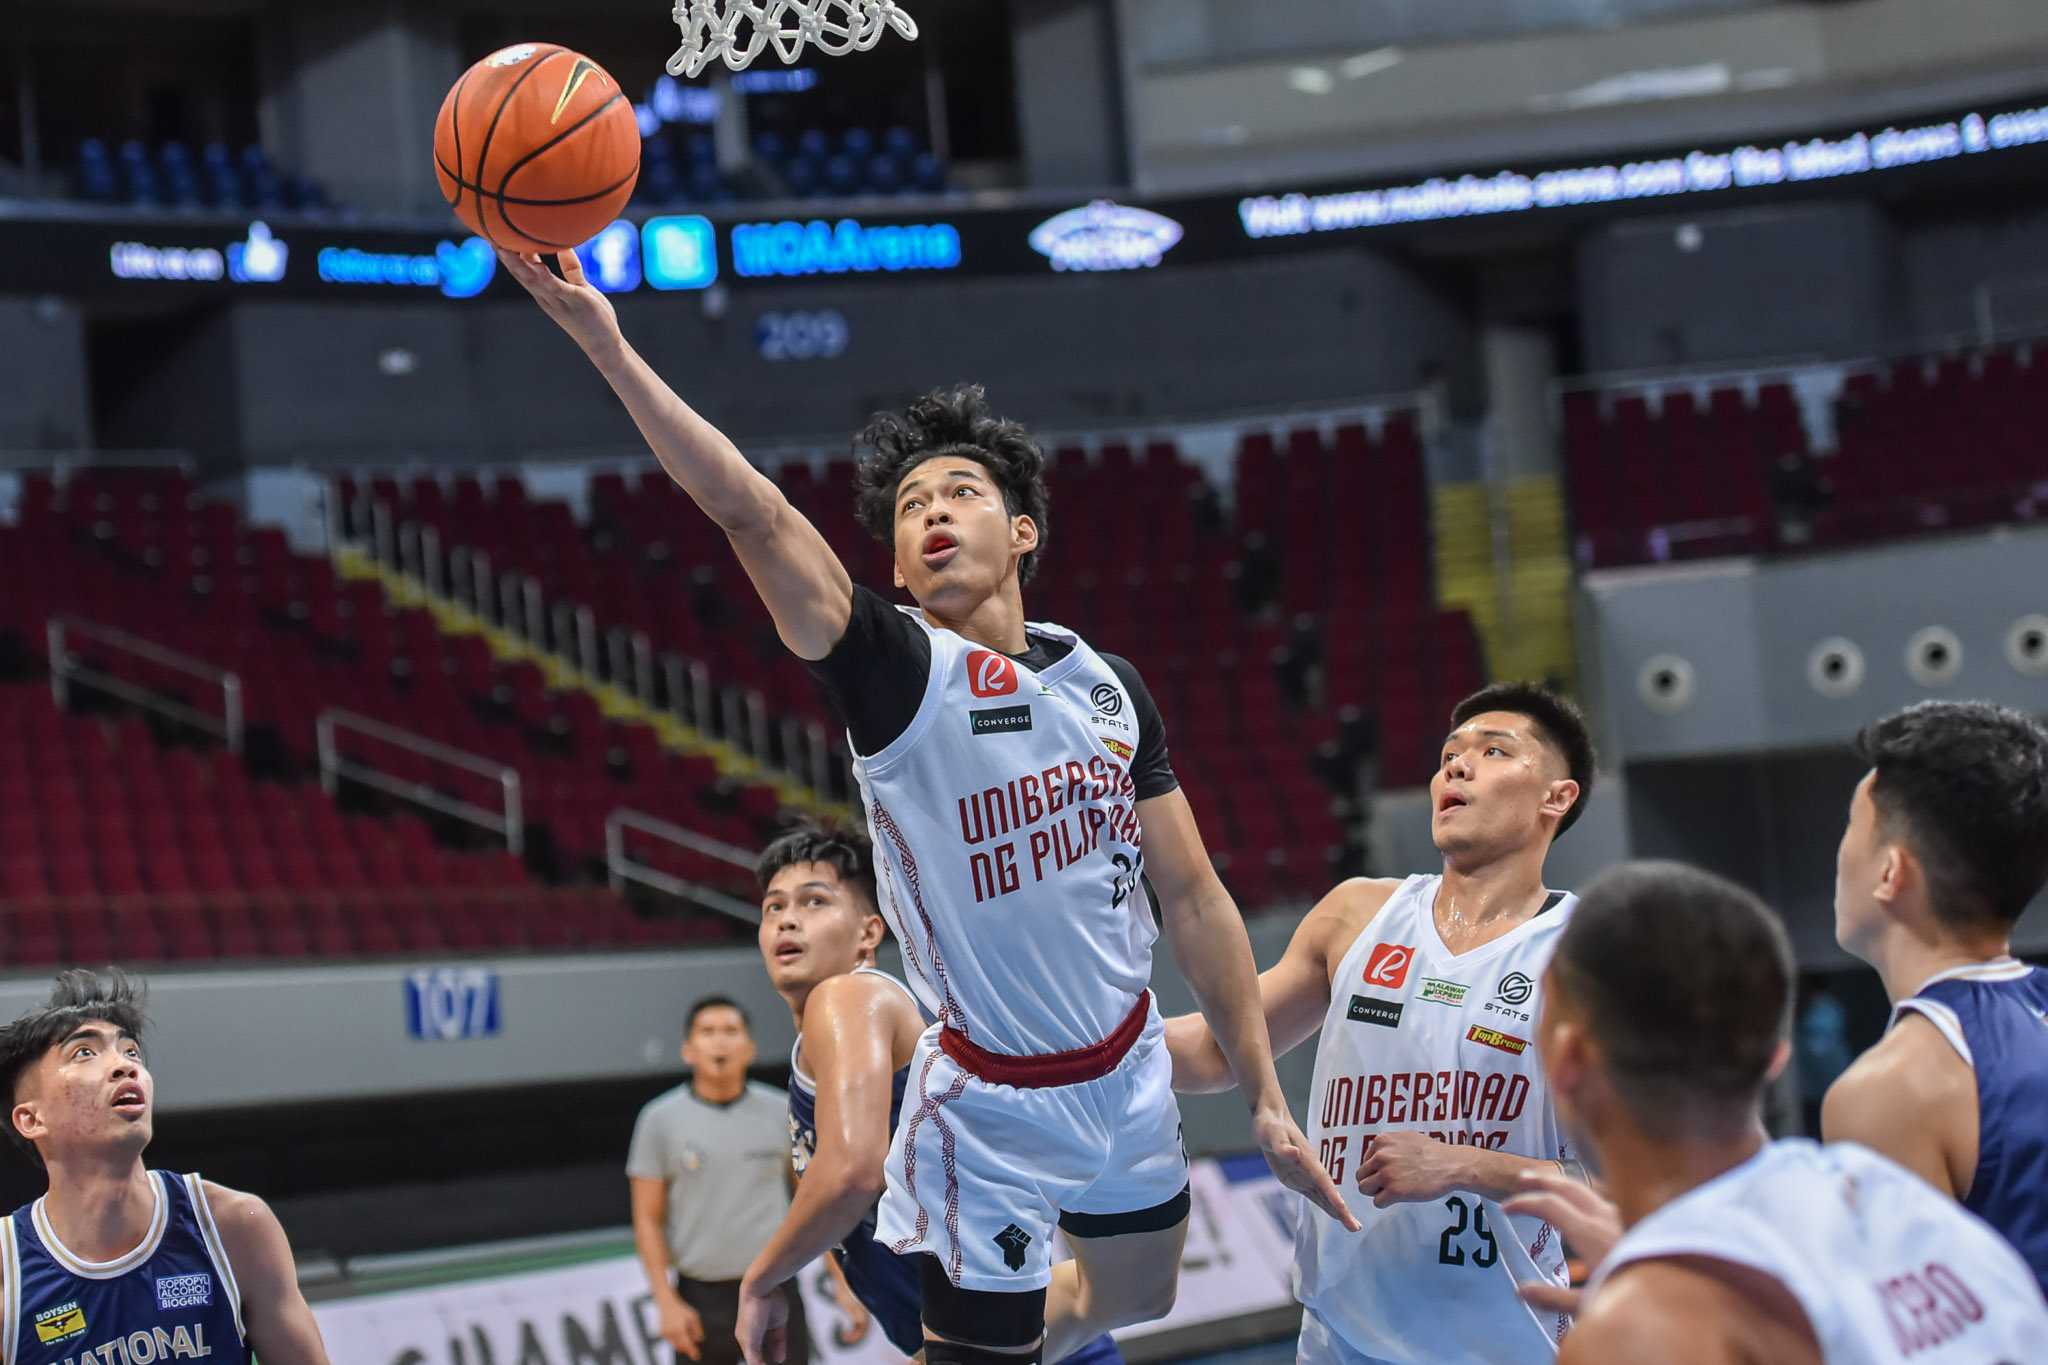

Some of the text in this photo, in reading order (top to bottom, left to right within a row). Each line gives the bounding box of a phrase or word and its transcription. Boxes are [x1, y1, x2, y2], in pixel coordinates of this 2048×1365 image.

[977, 715, 1030, 728] CONVERGE
[1091, 716, 1129, 731] STATS
[969, 841, 1021, 903] NG
[415, 966, 488, 1039] 107
[1483, 1002, 1530, 1022] STATS
[1352, 1005, 1400, 1021] CONVERGE
[1471, 1026, 1525, 1053] TopBreed
[1321, 1070, 1530, 1128] UNIBERSIDAD
[1439, 1196, 1498, 1269] 29
[159, 1276, 209, 1290] ISOPROPYL
[161, 1285, 207, 1297] ALCOHOL
[35, 1301, 77, 1322] BOYSEN
[161, 1296, 209, 1309] BIOGENIC
